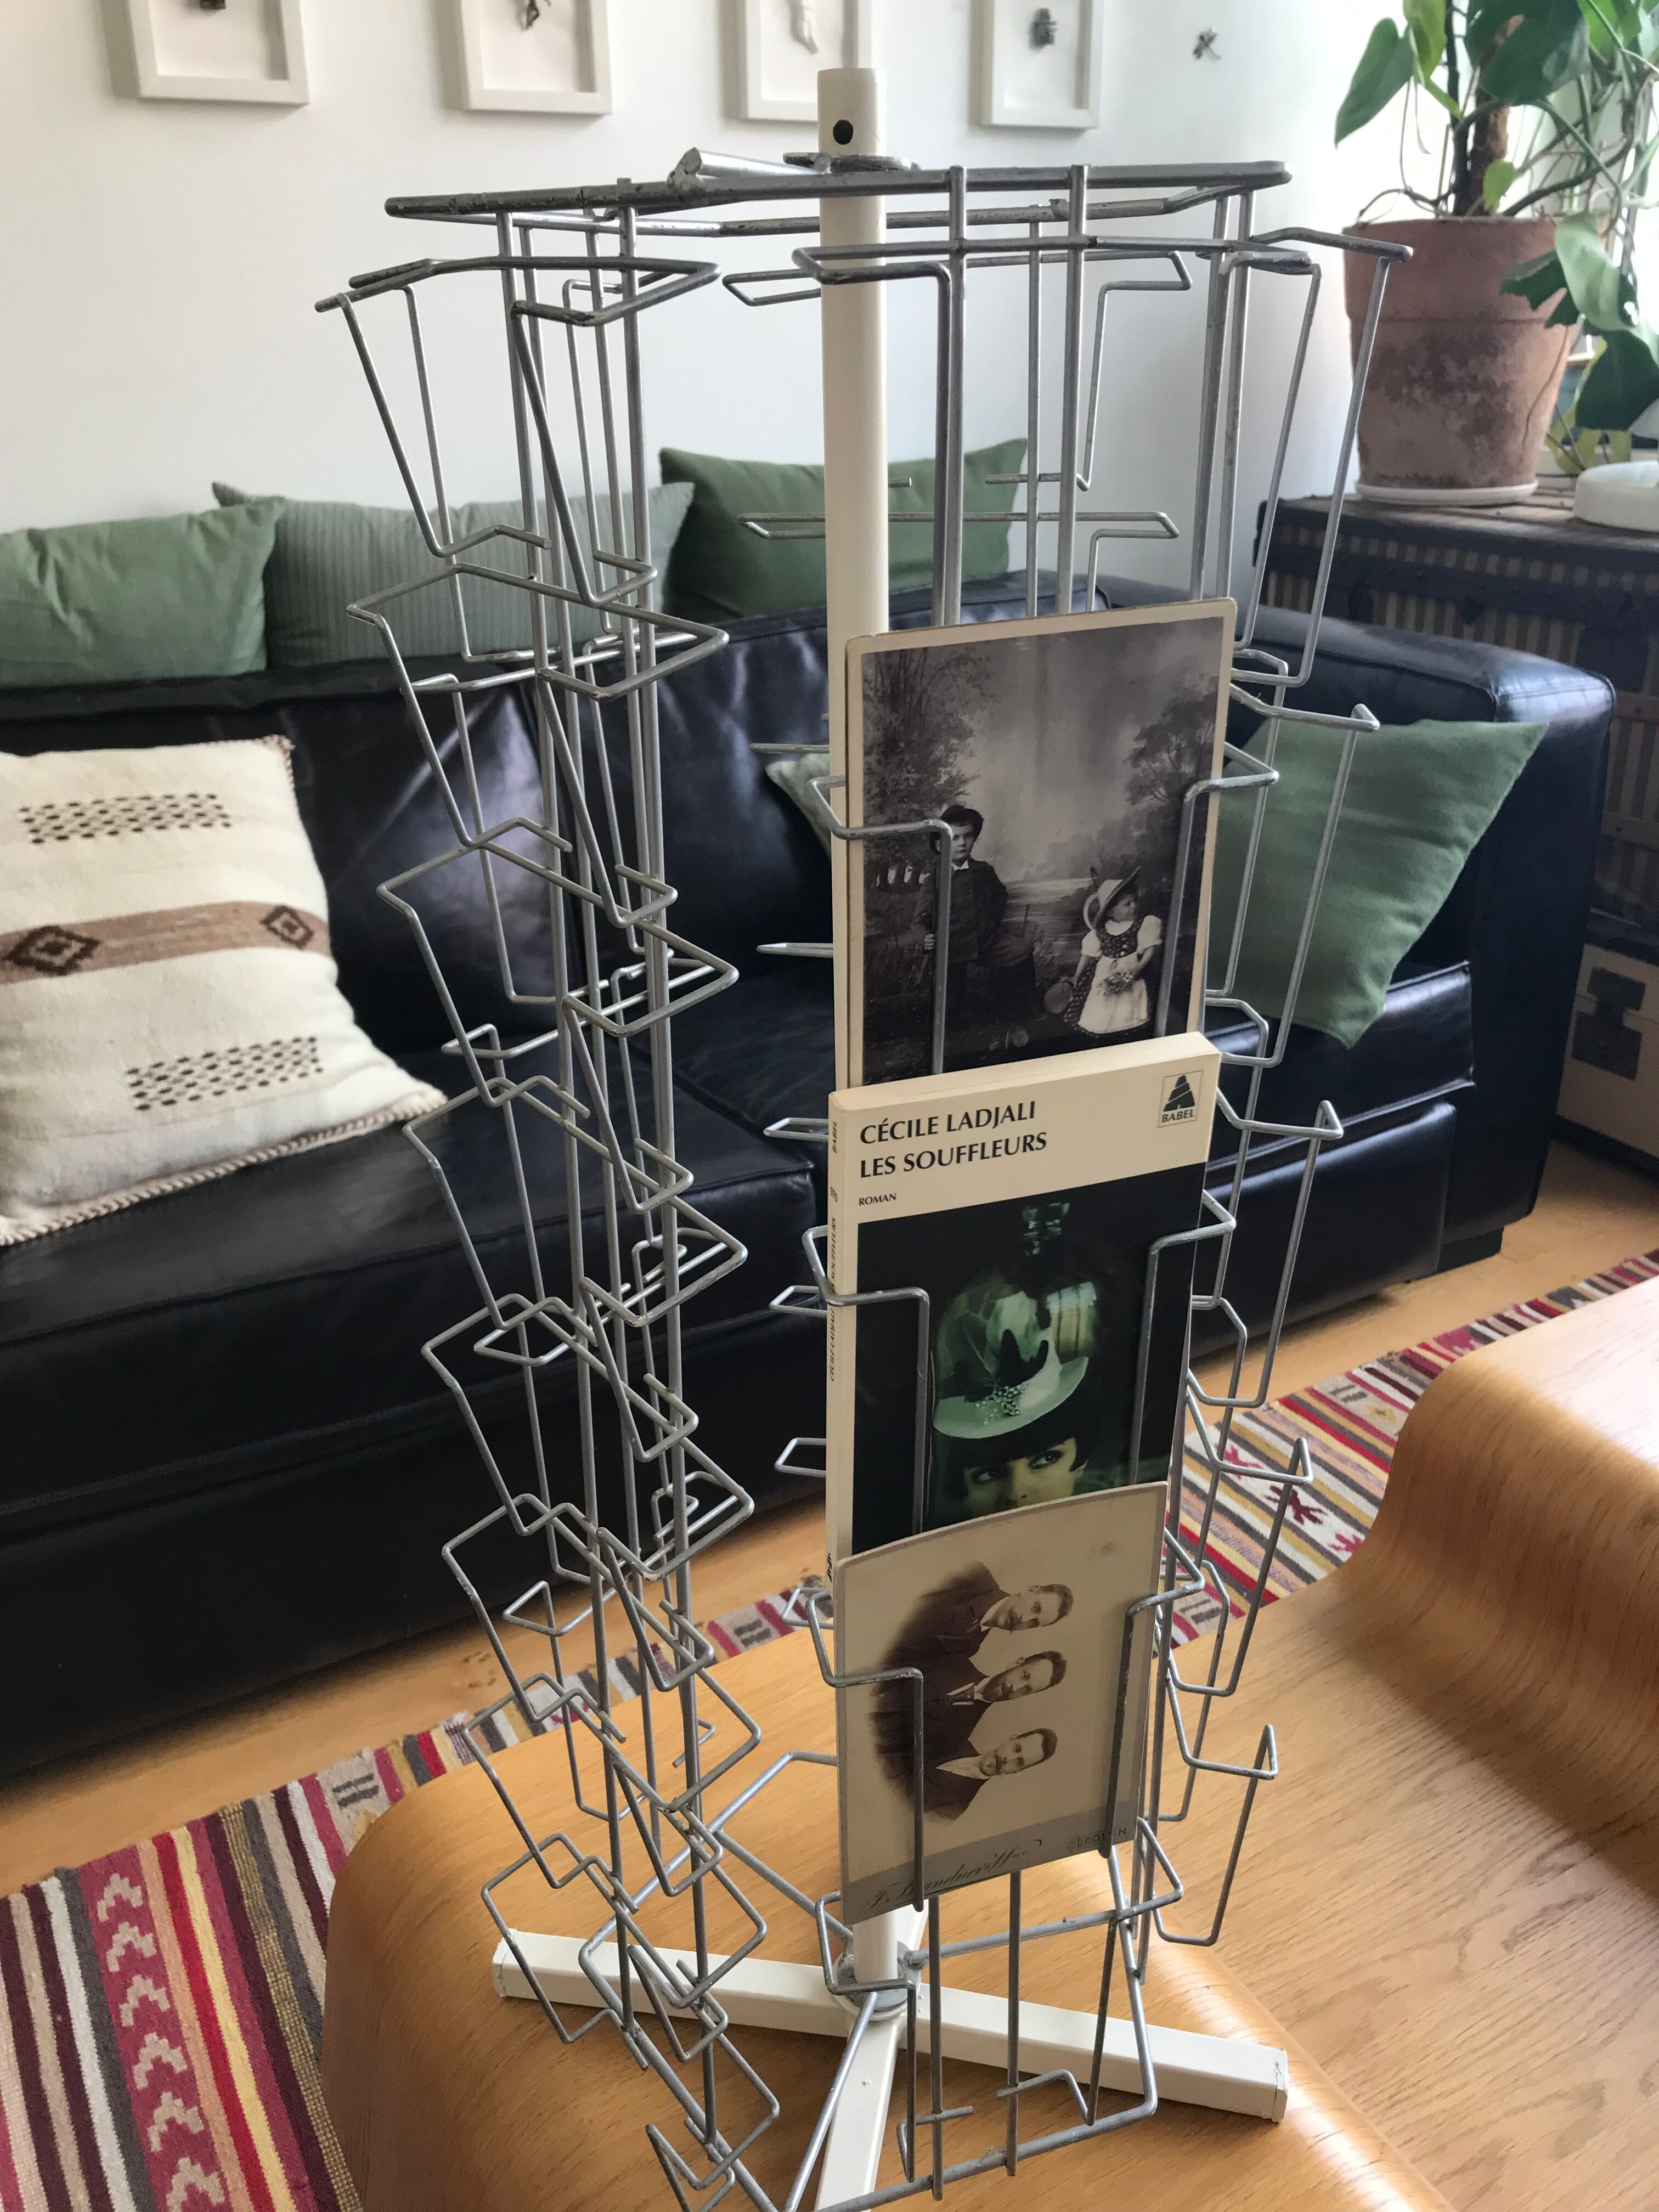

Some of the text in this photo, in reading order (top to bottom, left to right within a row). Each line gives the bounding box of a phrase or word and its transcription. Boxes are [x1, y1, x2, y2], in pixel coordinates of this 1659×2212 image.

[860, 1101, 1035, 1144] CÉCILE LADJALI
[1161, 1109, 1194, 1123] BABEL
[860, 1132, 1047, 1178] LES SOUFFLEURS
[859, 1193, 897, 1206] ROMAN
